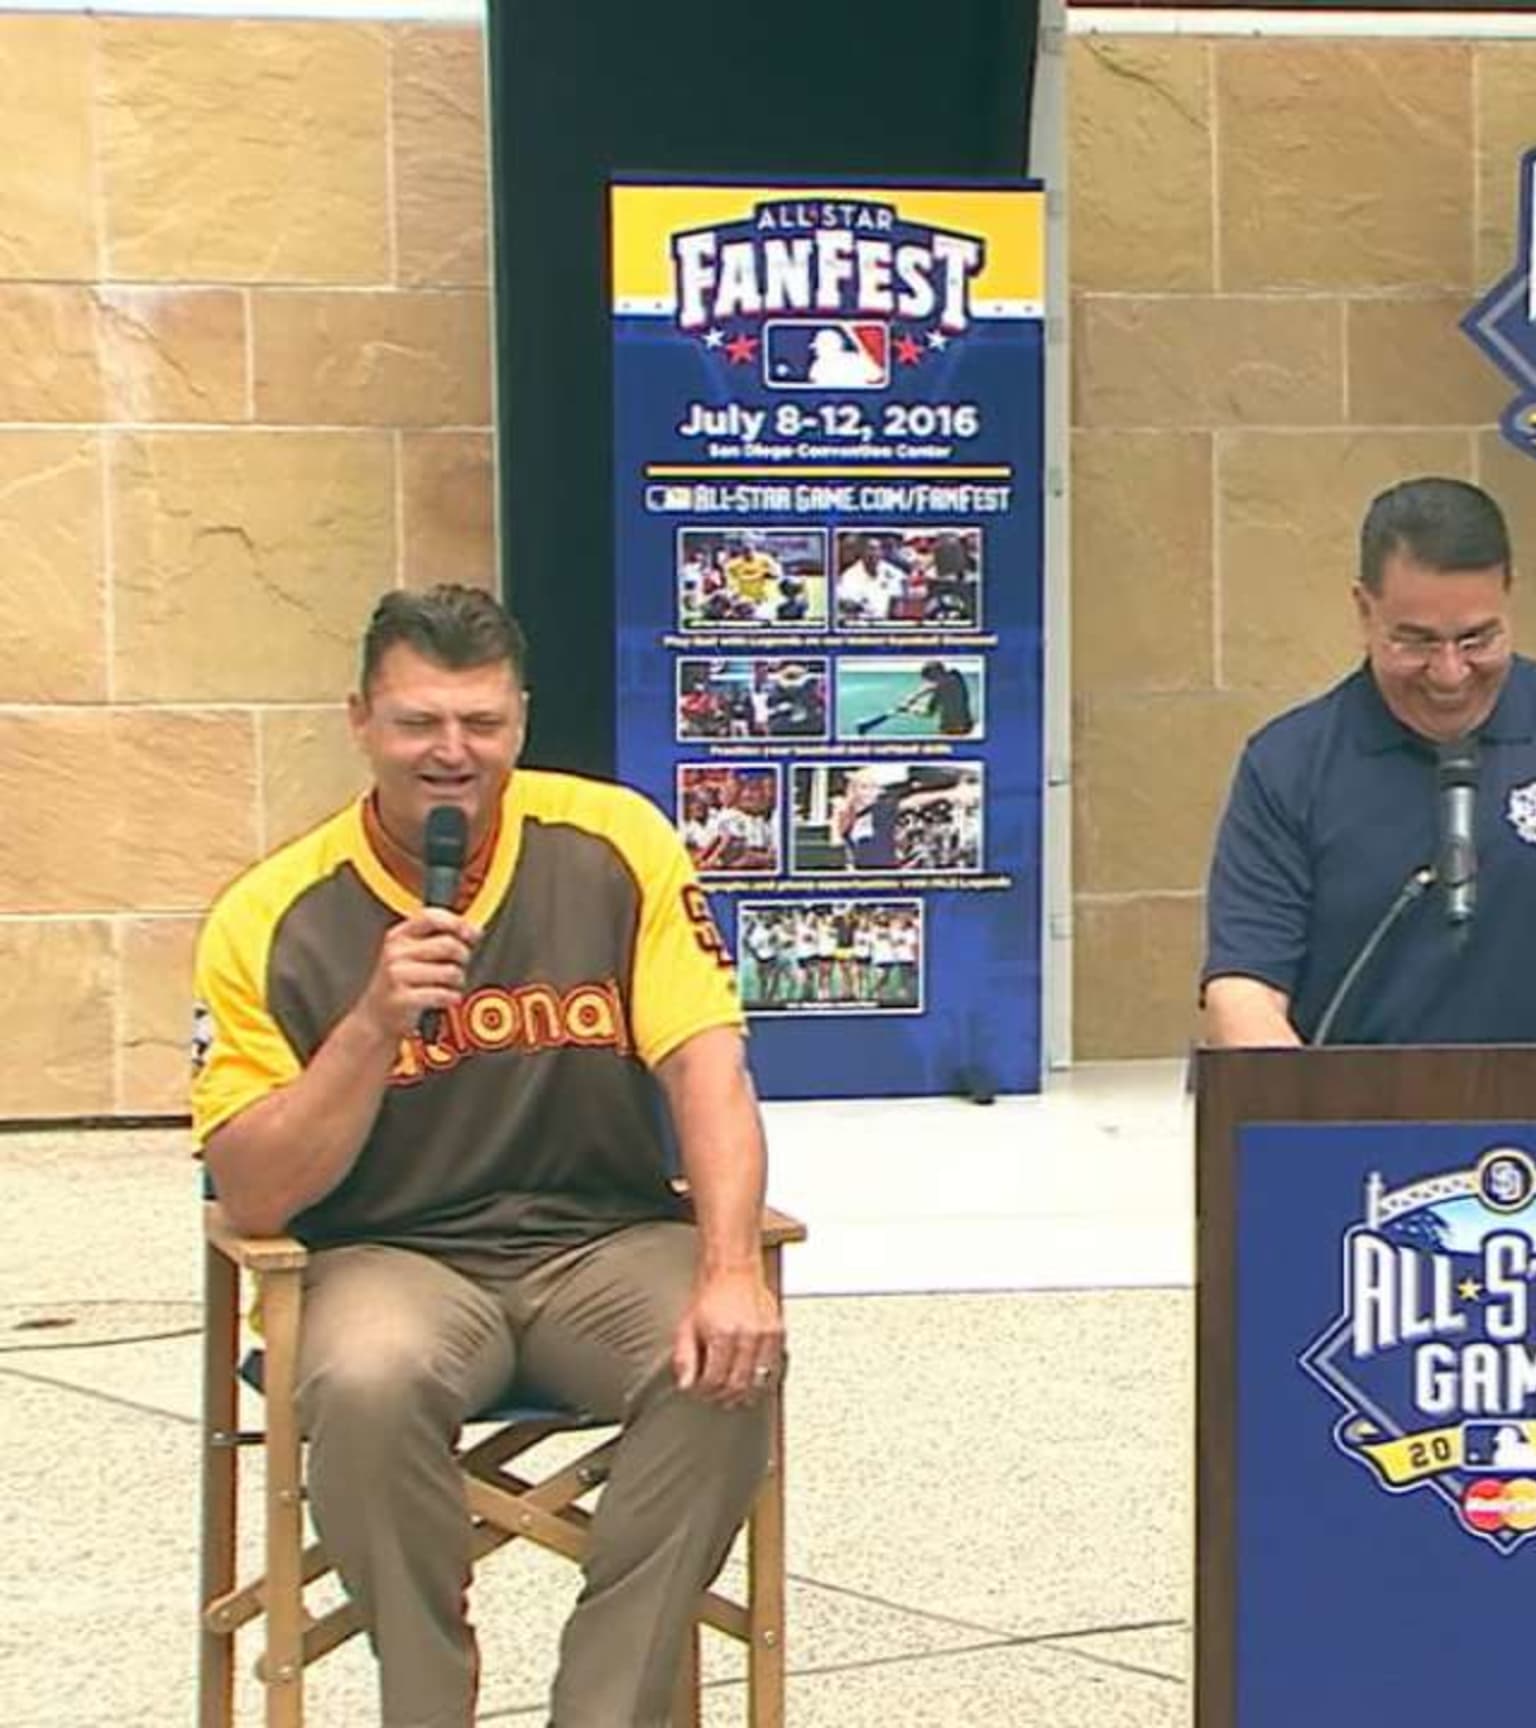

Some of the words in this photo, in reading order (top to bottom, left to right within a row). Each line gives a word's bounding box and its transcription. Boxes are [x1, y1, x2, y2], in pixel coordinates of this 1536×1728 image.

[677, 228, 982, 330] FANFEST
[679, 404, 765, 441] July
[776, 405, 873, 442] 8-12,
[883, 405, 979, 437] 2016
[1352, 1232, 1468, 1358] ALL
